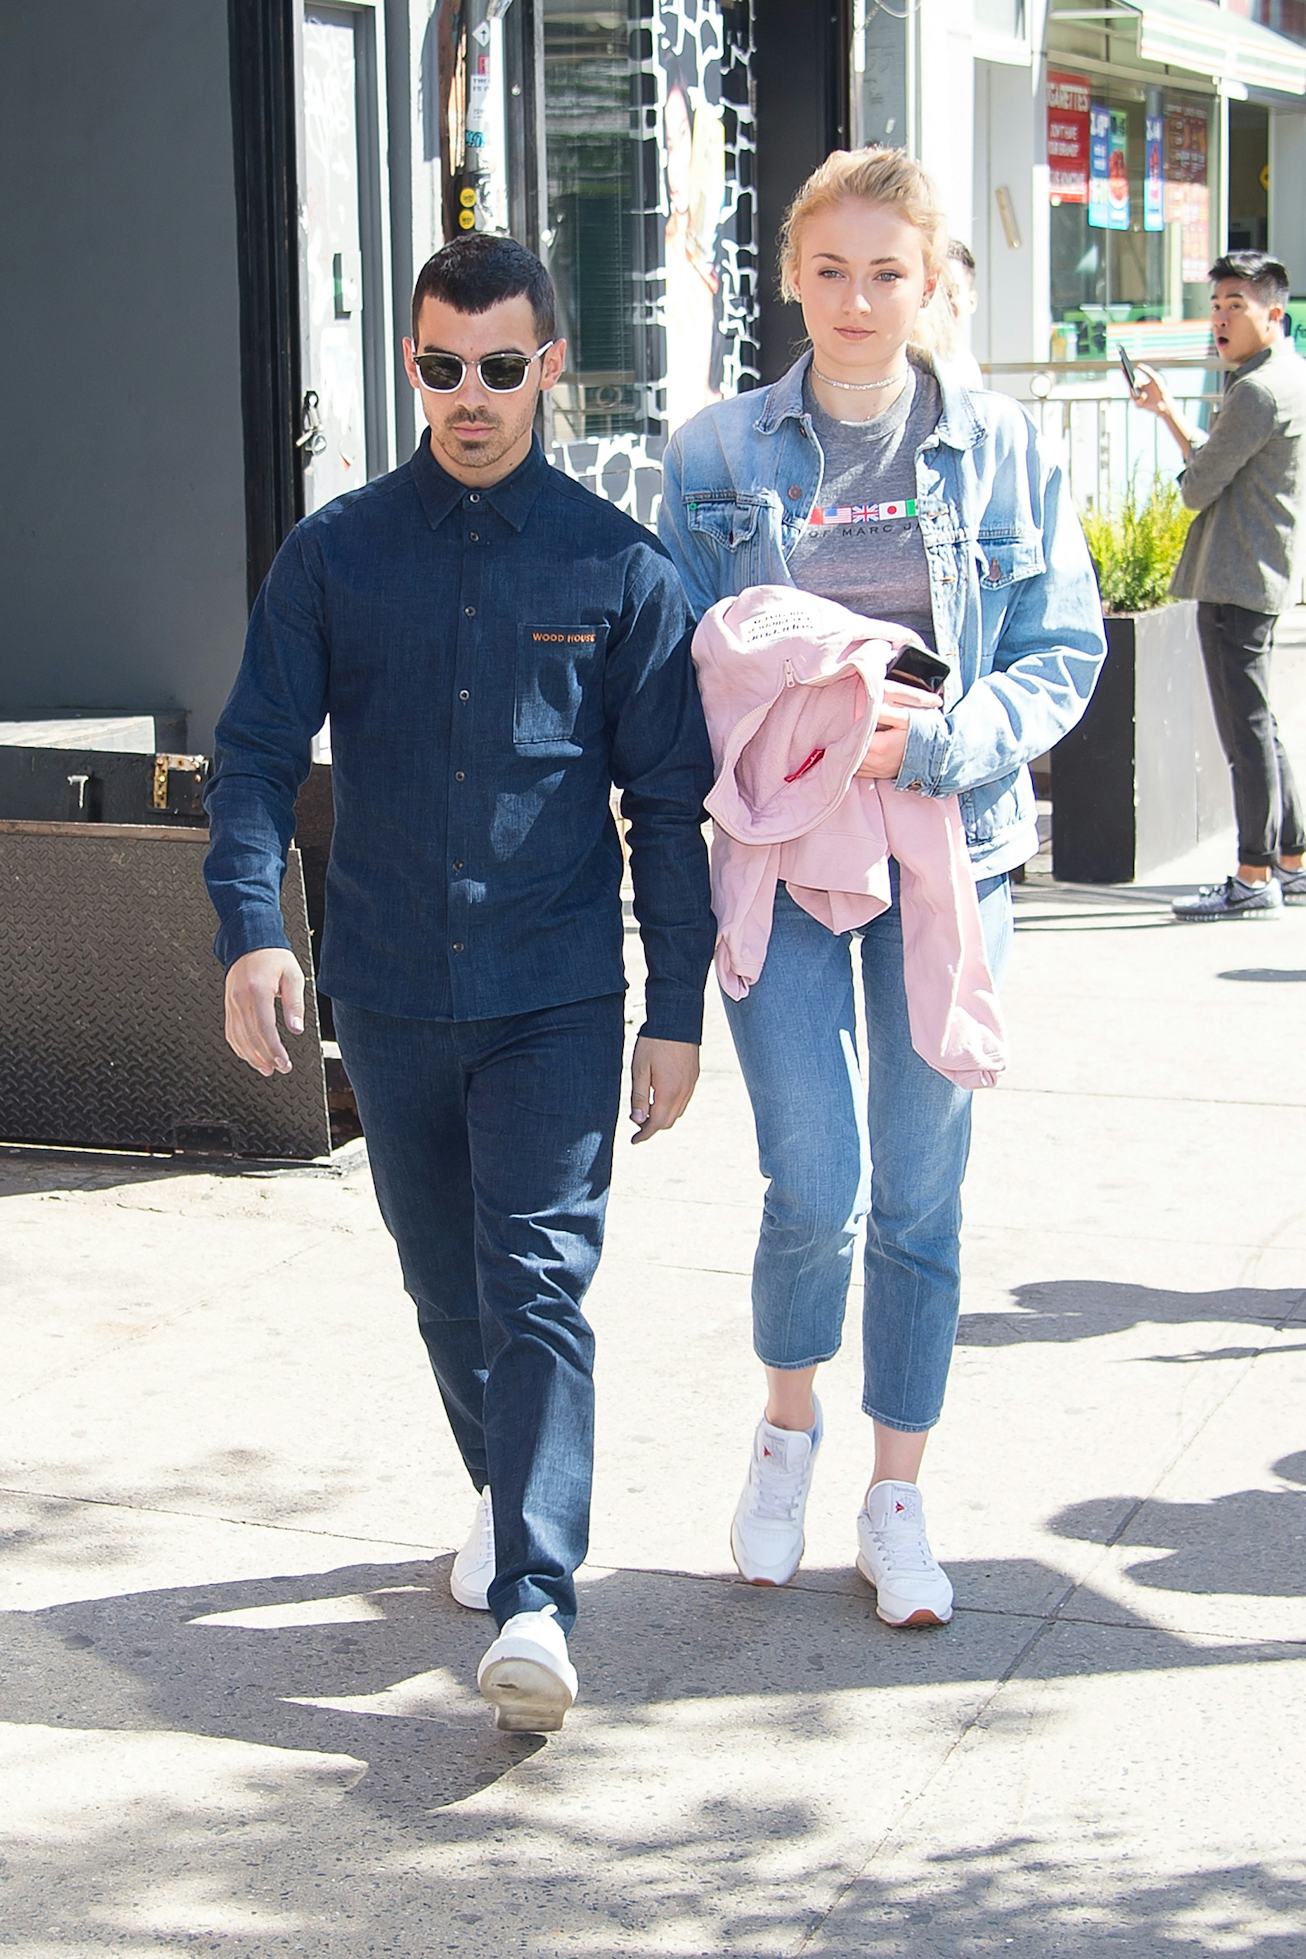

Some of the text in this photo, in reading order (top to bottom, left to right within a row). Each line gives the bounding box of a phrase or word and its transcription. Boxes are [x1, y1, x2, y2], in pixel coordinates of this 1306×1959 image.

[808, 530, 831, 538] OF
[842, 524, 893, 537] MARC
[532, 632, 596, 643] WOOD HOUSE
